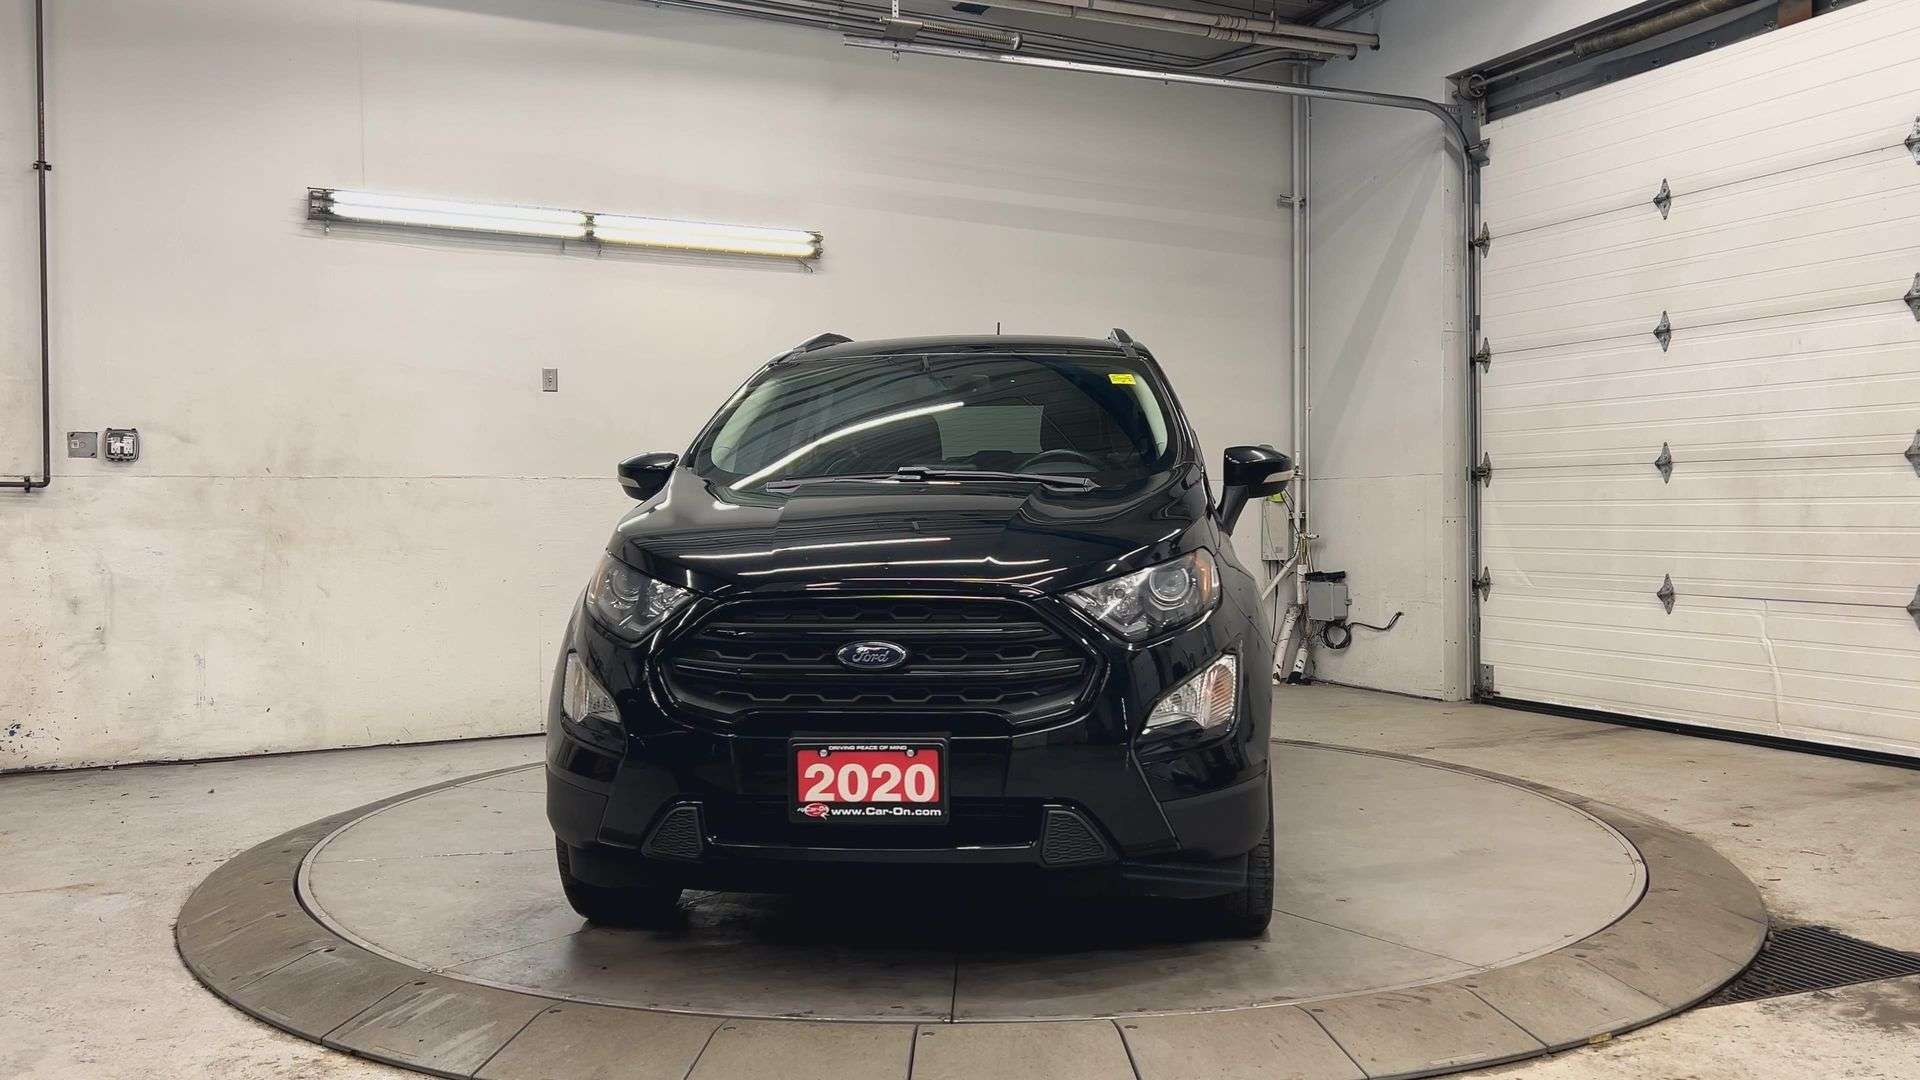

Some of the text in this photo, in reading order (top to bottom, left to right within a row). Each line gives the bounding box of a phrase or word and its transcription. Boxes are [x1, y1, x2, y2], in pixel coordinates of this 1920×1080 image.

[852, 646, 890, 662] Ford
[804, 763, 936, 802] 2020
[831, 806, 942, 816] www.Car-On.com
